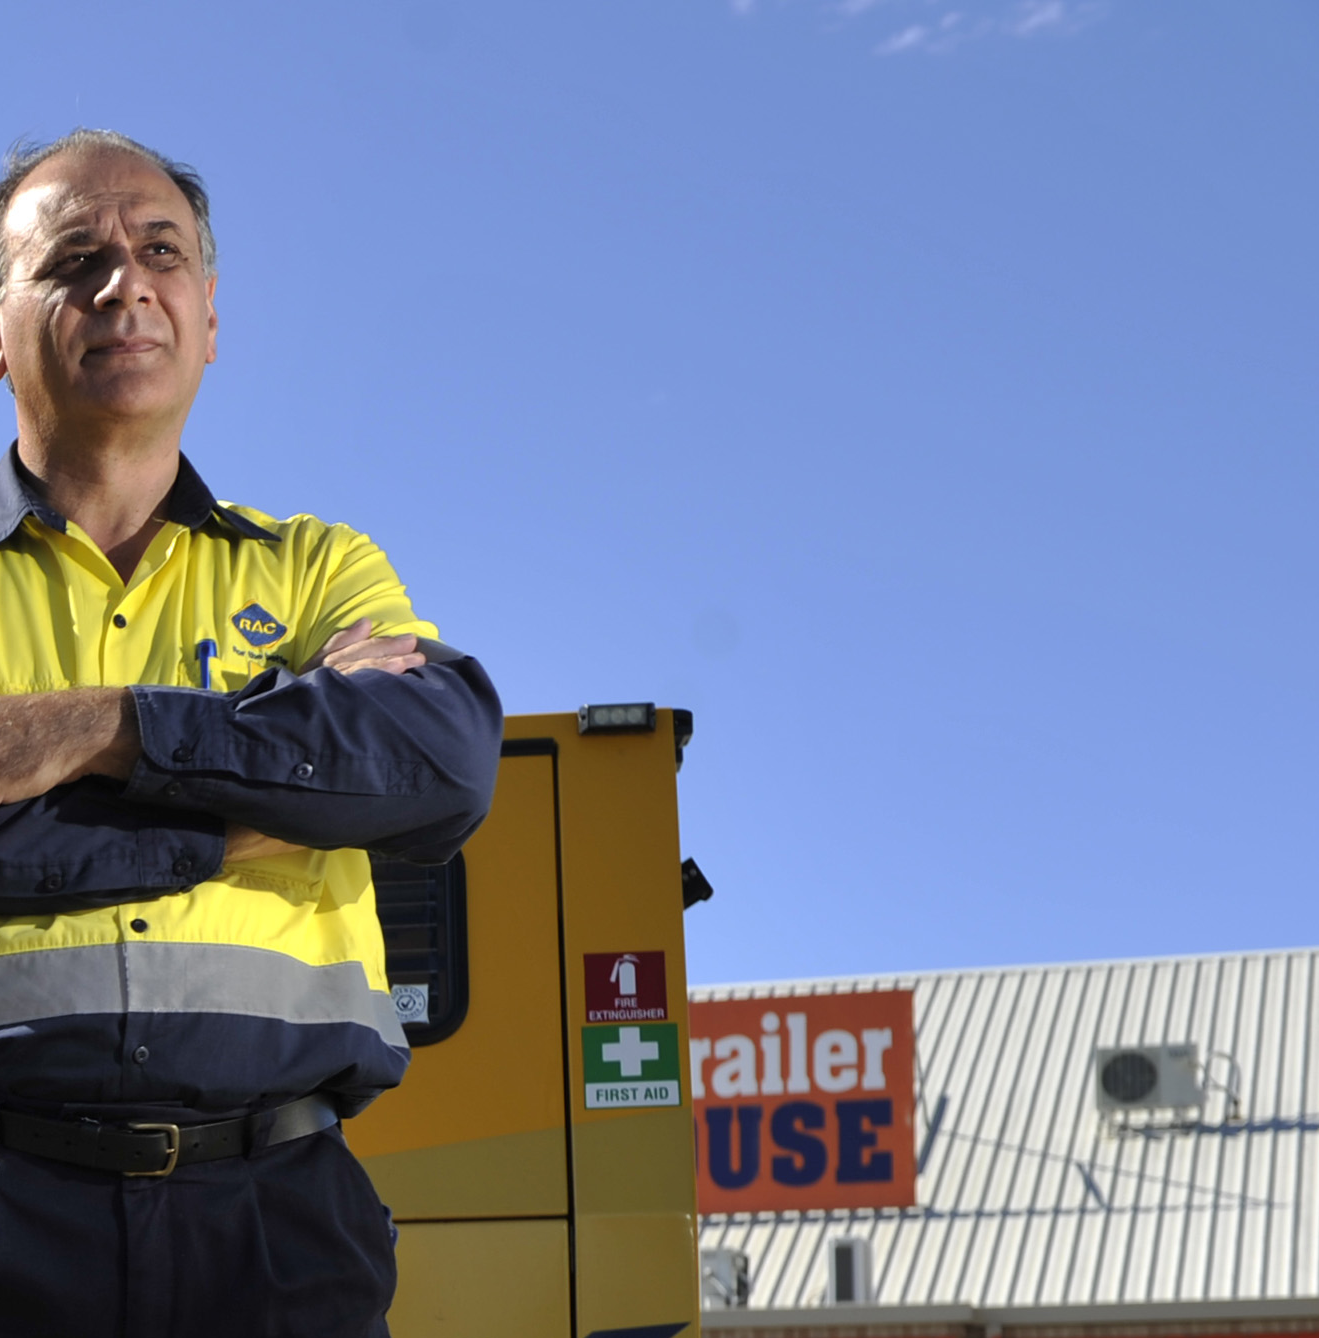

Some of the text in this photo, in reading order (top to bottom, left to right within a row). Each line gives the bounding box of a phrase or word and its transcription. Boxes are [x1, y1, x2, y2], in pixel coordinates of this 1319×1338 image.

[239, 617, 277, 635] RAC
[614, 997, 638, 1009] FIRE
[588, 1008, 665, 1022] EXTINGUISHER
[688, 1011, 893, 1099] railer
[596, 1086, 669, 1102] FIRST AID
[694, 1097, 893, 1191] USE
